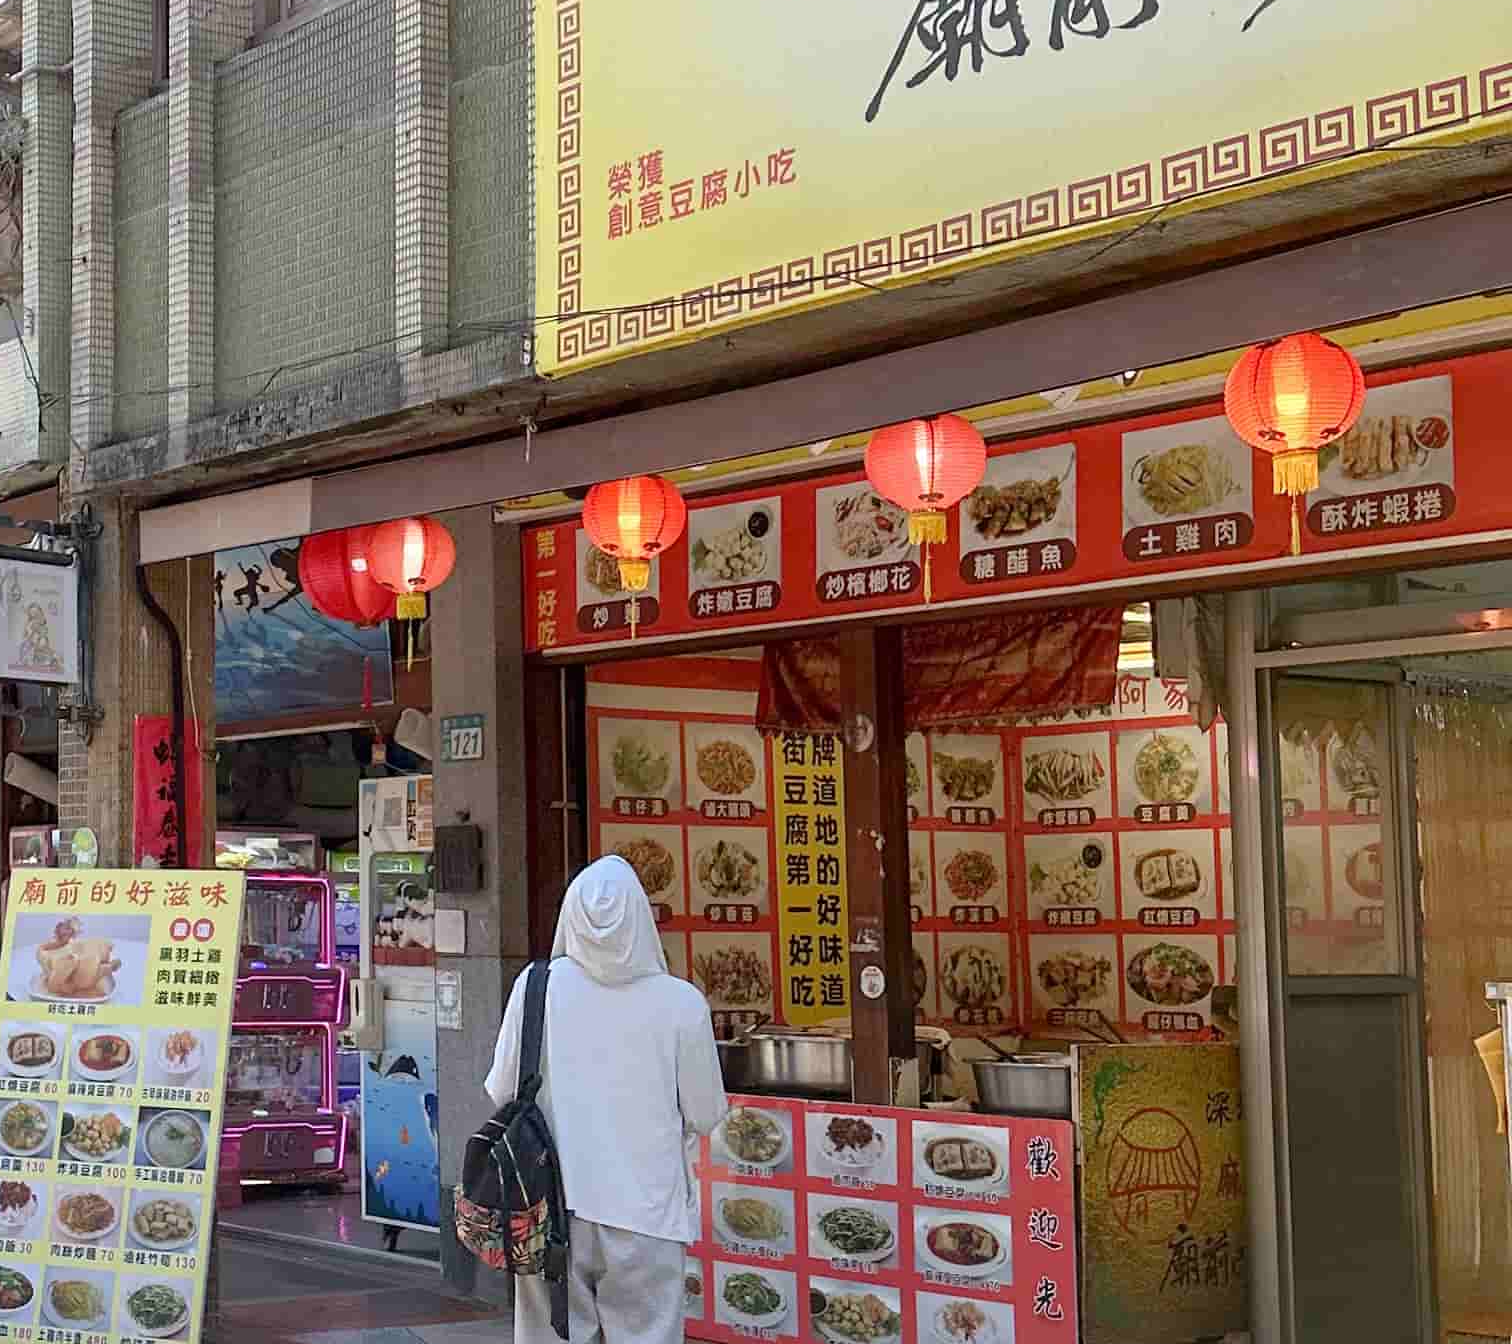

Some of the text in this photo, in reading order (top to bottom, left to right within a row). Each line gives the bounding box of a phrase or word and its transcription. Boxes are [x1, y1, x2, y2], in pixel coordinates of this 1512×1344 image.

[607, 149, 664, 200] 榮獲
[607, 148, 797, 240] 創意豆腐小吃
[1319, 489, 1442, 531] 酥炸蝦捲
[1138, 518, 1240, 556] 土雞肉
[974, 544, 1062, 579] 糖醋魚
[535, 529, 560, 648] 第一好吃
[824, 566, 913, 600] 炒檳榔花
[696, 589, 774, 617] 炸嫩豆腐
[453, 731, 479, 757] 121
[18, 876, 230, 908] 廟前的好滋味
[154, 991, 218, 1007] 滋味鮮美
[119, 1087, 133, 1098] 70
[195, 1091, 210, 1103] 20
[105, 1166, 126, 1179] 100
[175, 1256, 196, 1269] 130
